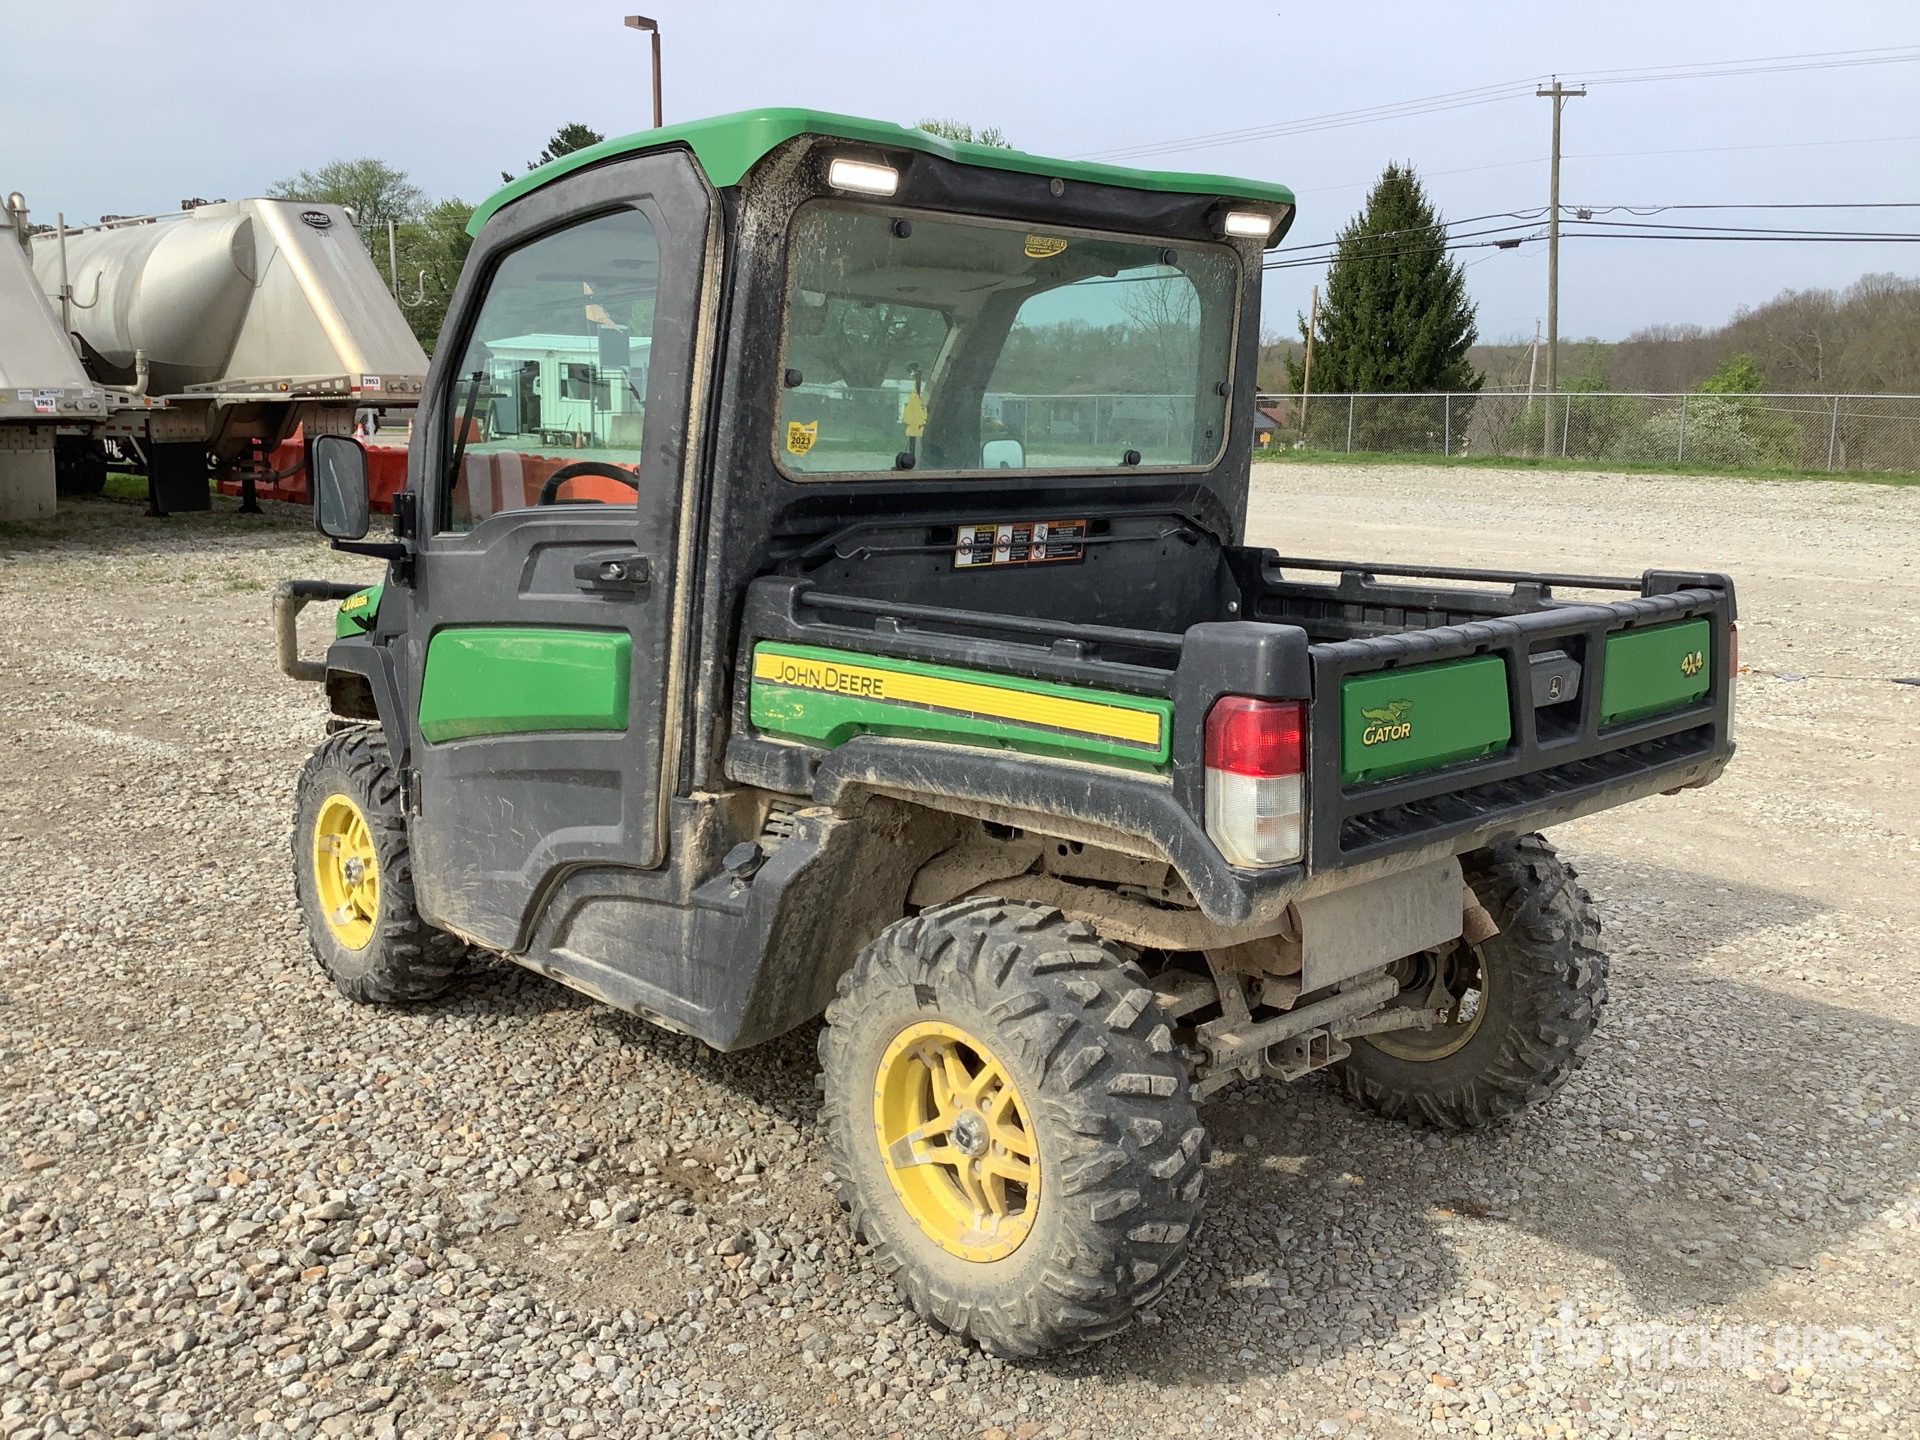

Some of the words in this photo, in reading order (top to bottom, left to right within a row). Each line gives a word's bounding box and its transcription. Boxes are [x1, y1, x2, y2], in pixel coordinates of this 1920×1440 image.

[791, 436, 811, 445] 2023
[775, 661, 821, 686] JOHN
[824, 667, 884, 696] DEERE
[1363, 722, 1411, 745] GATOR
